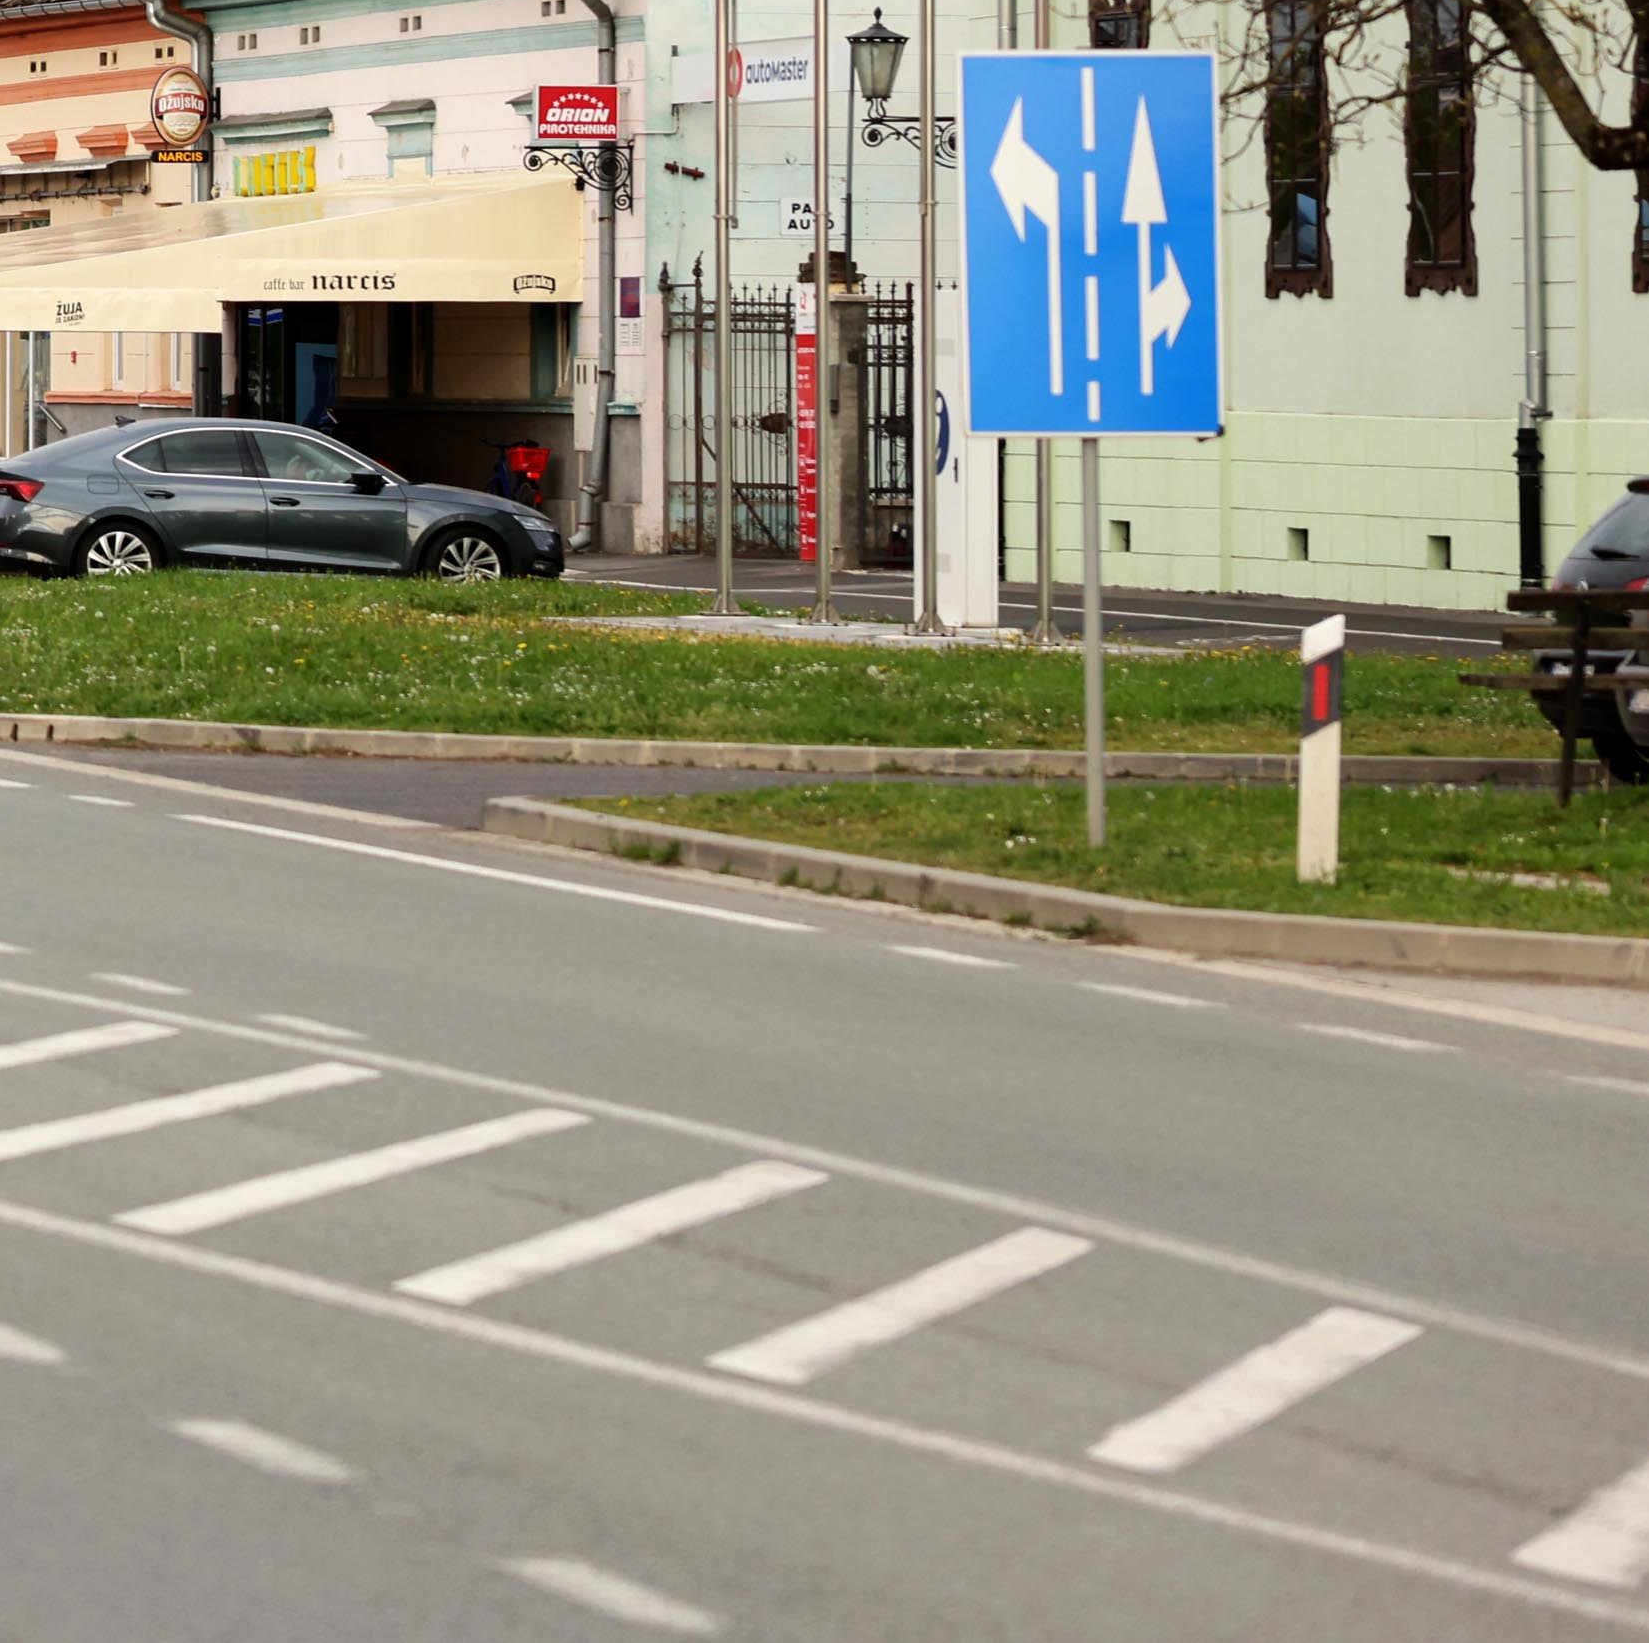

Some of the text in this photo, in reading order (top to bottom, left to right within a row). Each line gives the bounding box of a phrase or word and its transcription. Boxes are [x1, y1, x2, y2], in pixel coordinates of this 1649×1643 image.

[158, 93, 205, 113] Ožujsko
[546, 107, 610, 123] ORION
[539, 123, 617, 135] PIROTEHNIKA
[158, 151, 204, 162] NARCIS
[288, 278, 305, 290] bar
[311, 270, 396, 291] narcis
[56, 300, 83, 316] ŽUJA
